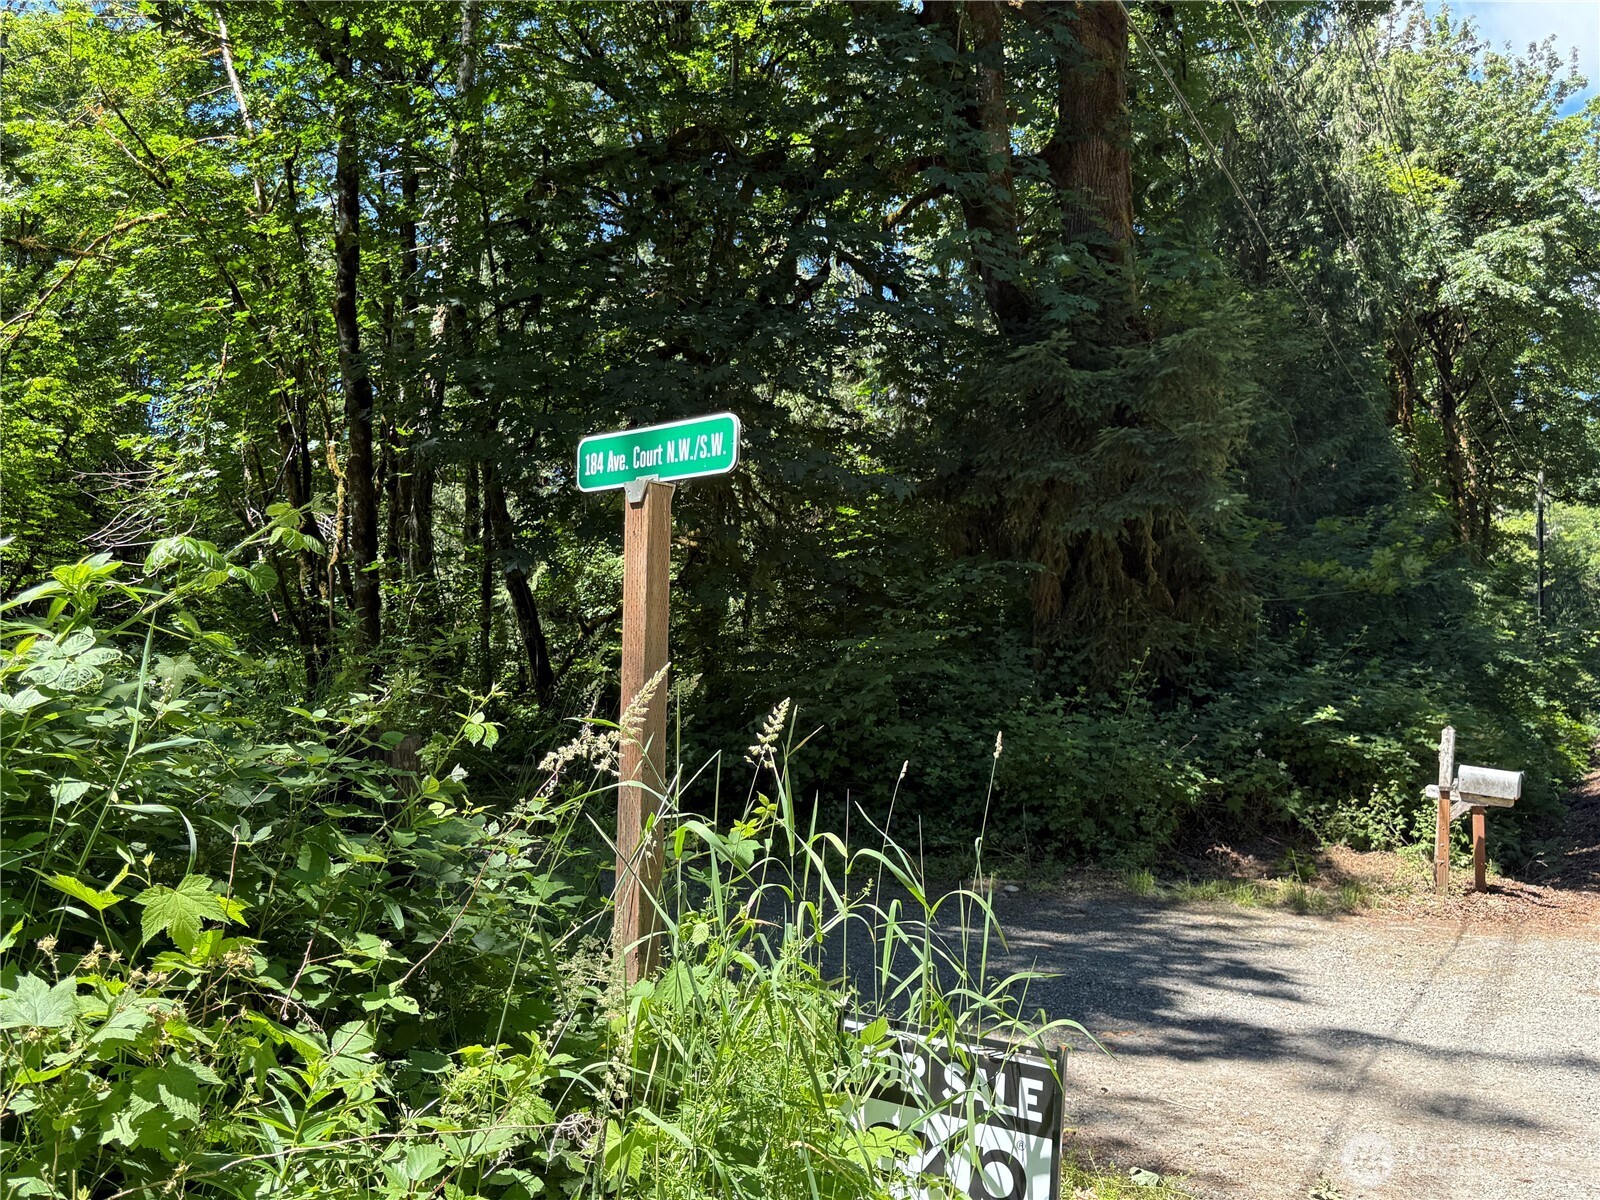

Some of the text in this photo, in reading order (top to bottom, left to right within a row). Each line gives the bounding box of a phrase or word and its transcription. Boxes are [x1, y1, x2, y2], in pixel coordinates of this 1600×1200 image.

[585, 432, 726, 475] 184 Ave. Court N.W./S.W.
[942, 1062, 1043, 1123] SALE
